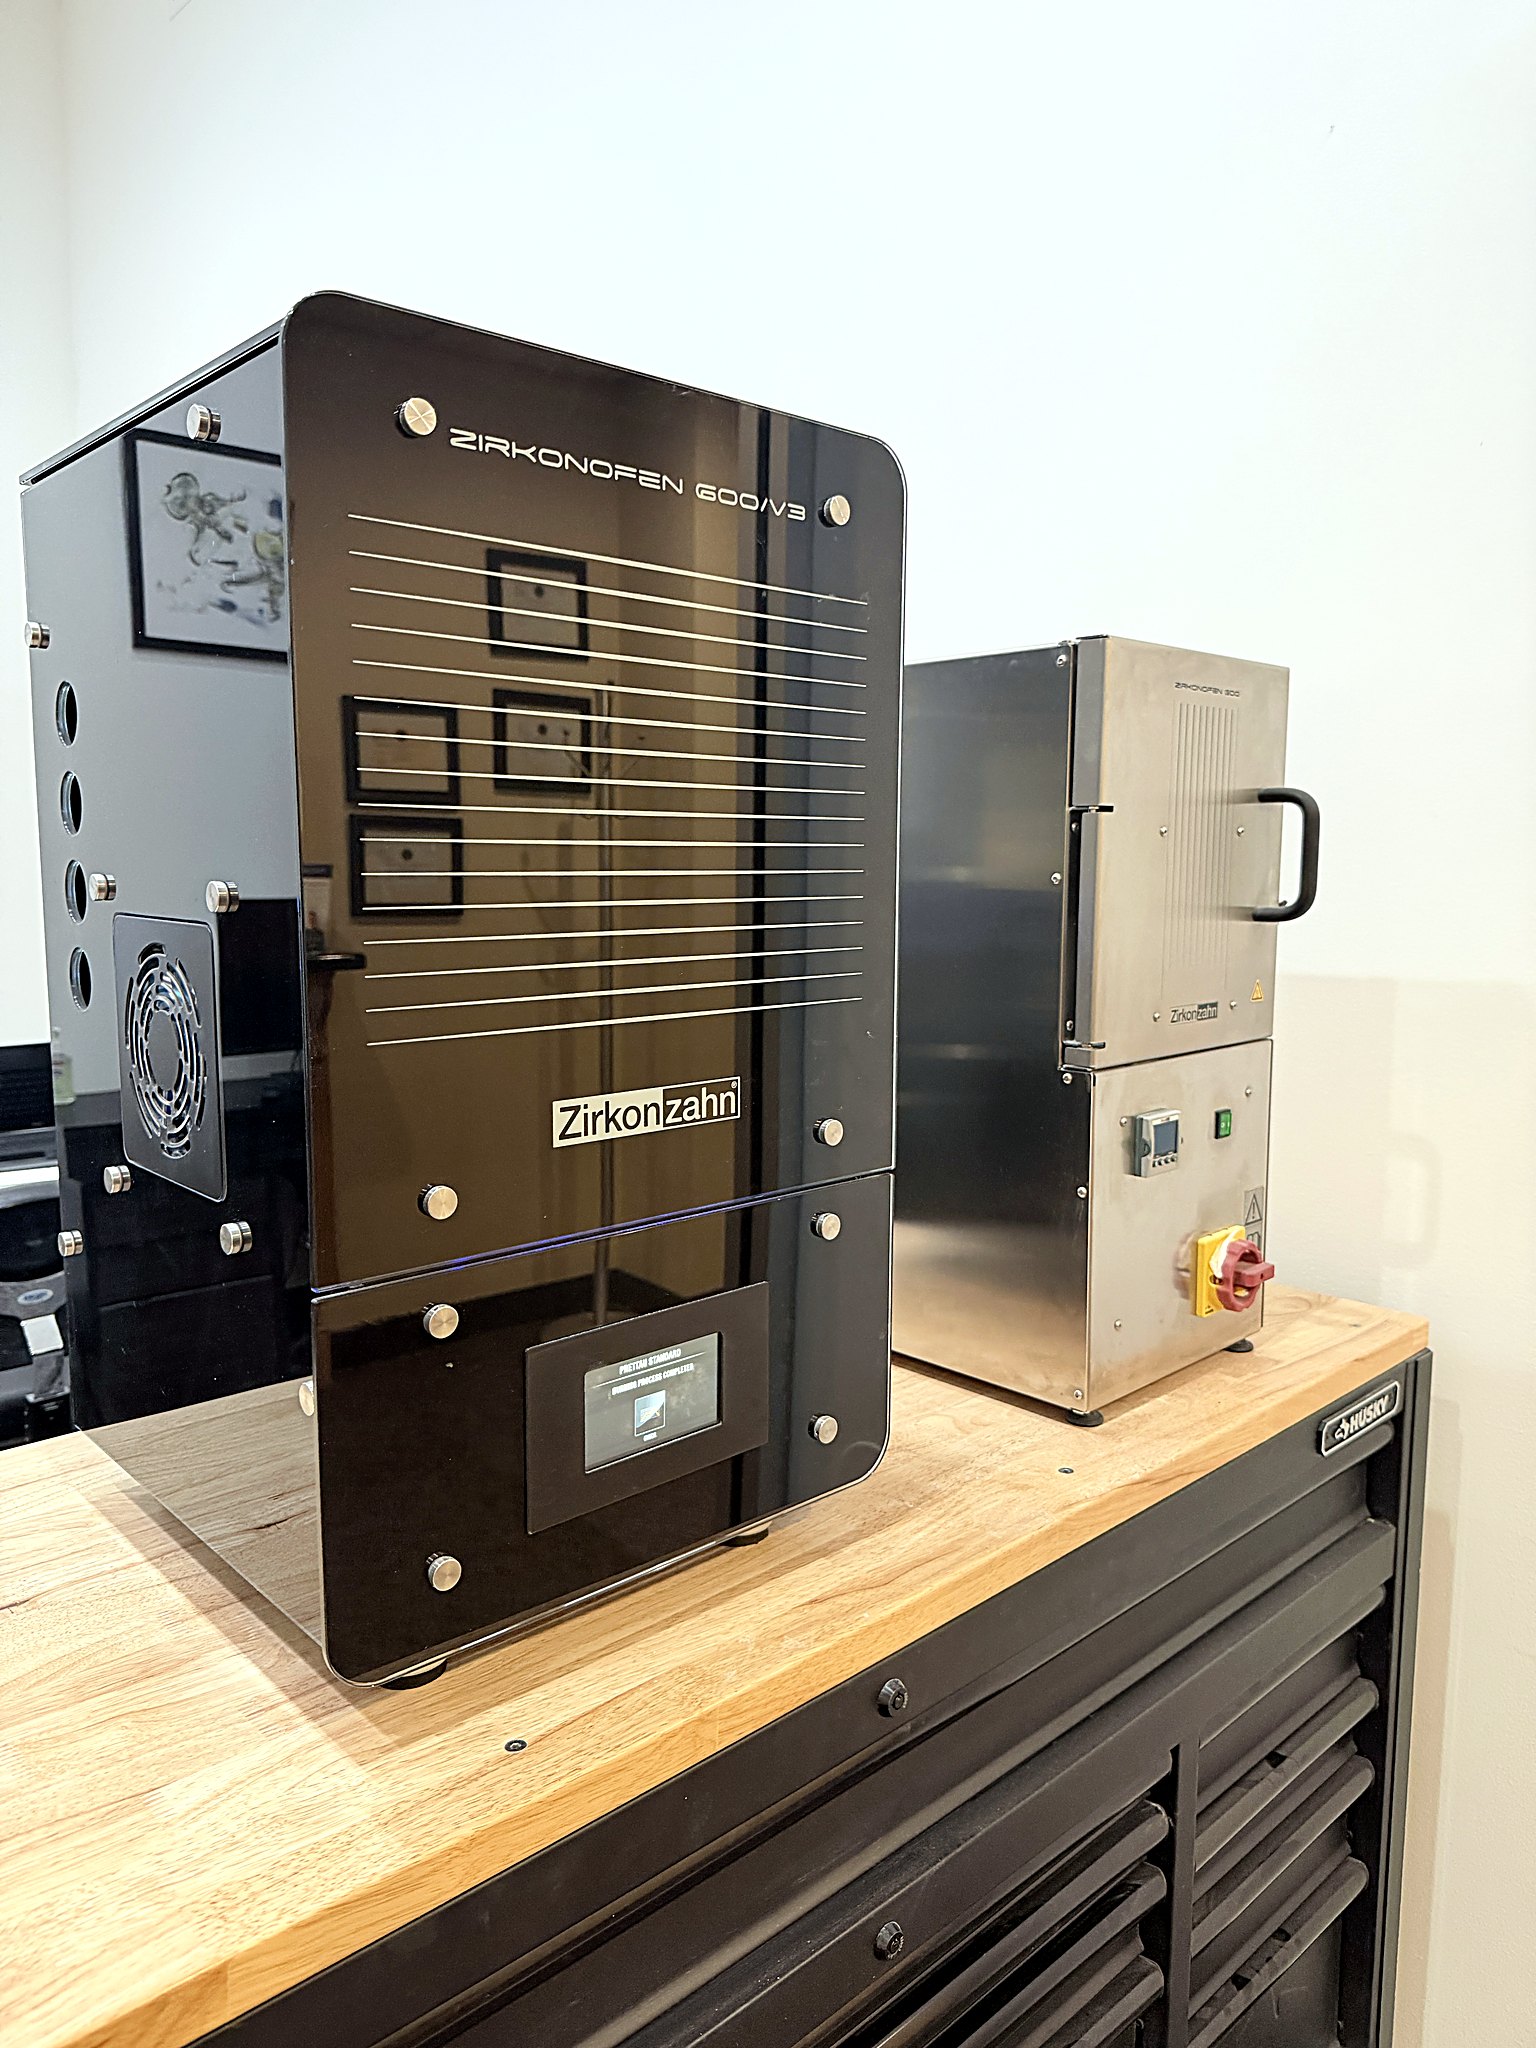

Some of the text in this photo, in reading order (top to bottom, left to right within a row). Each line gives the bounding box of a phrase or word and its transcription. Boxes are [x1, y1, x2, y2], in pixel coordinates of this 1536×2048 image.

[449, 427, 807, 521] ZIRKONOFEN 600/V3
[1170, 1005, 1217, 1023] Zirkonzahn
[648, 1348, 682, 1366] STANDARD
[637, 1372, 663, 1388] PROCESS
[1349, 1394, 1389, 1434] HUSKY
